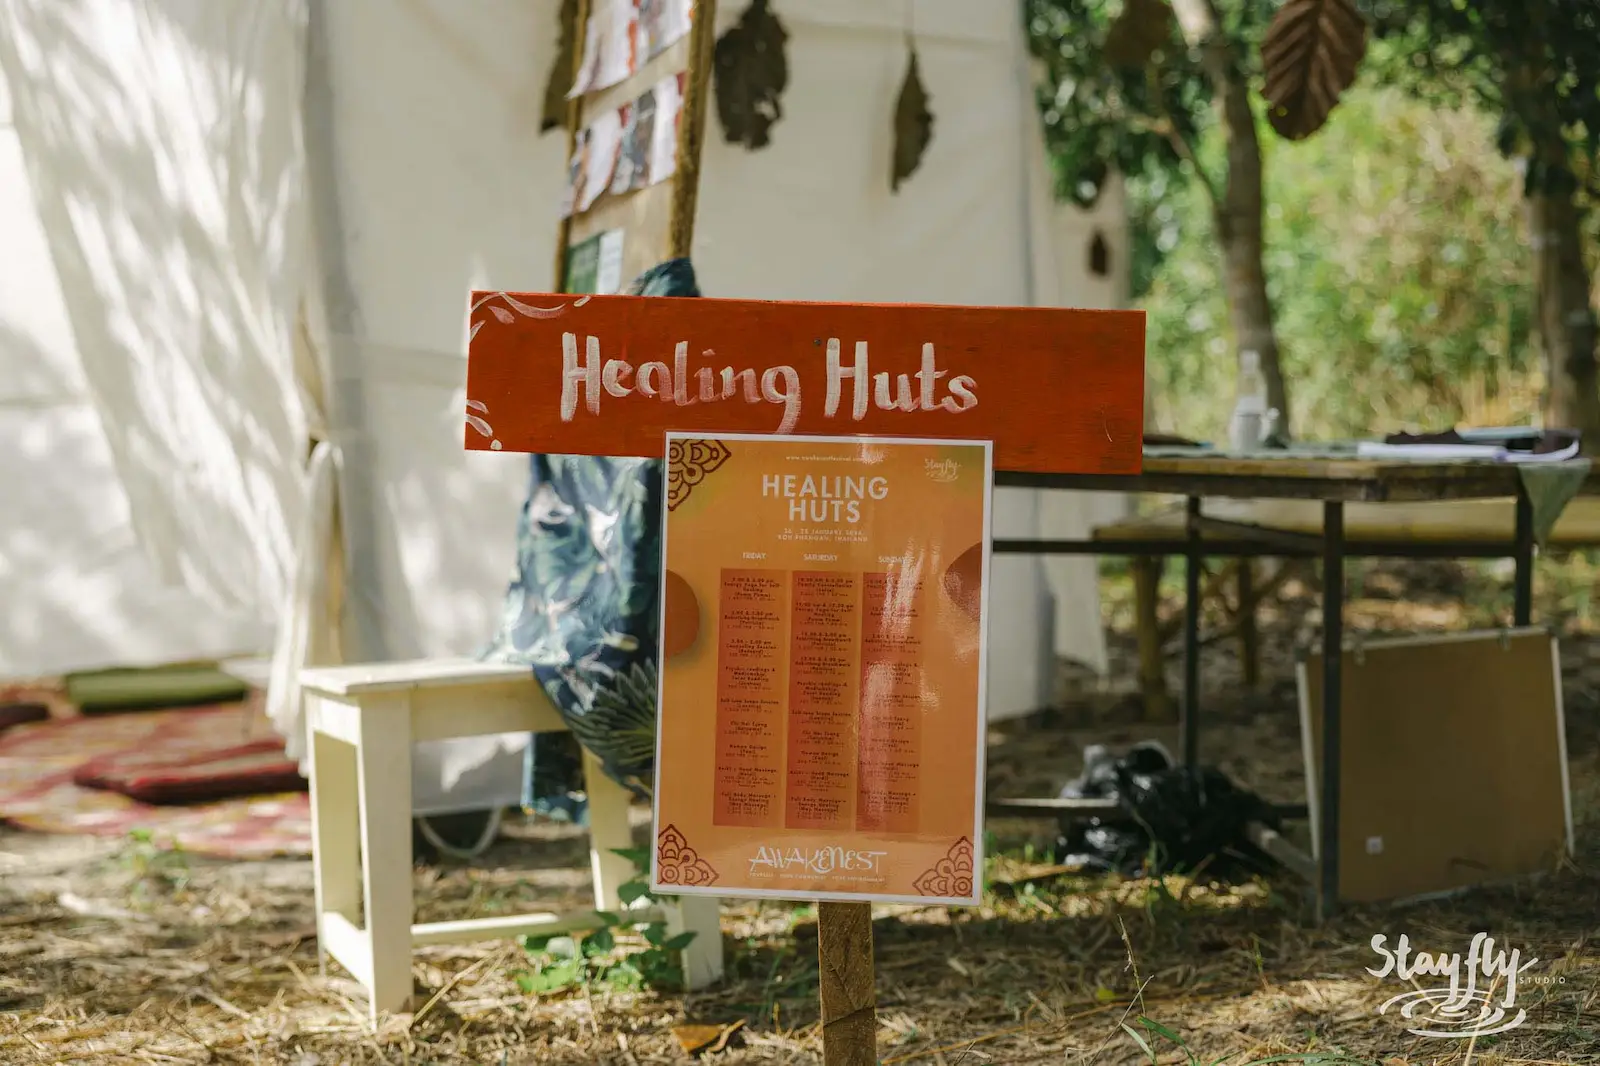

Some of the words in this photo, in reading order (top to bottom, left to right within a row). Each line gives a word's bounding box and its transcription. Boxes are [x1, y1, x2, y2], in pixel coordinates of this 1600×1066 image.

[560, 331, 801, 434] Healing
[824, 337, 978, 420] Huts
[762, 474, 889, 500] HEALING
[788, 499, 861, 523] HUTS
[742, 552, 766, 560] FRIDAY
[804, 553, 838, 561] SATURDAY
[878, 556, 909, 564] SUNDAY
